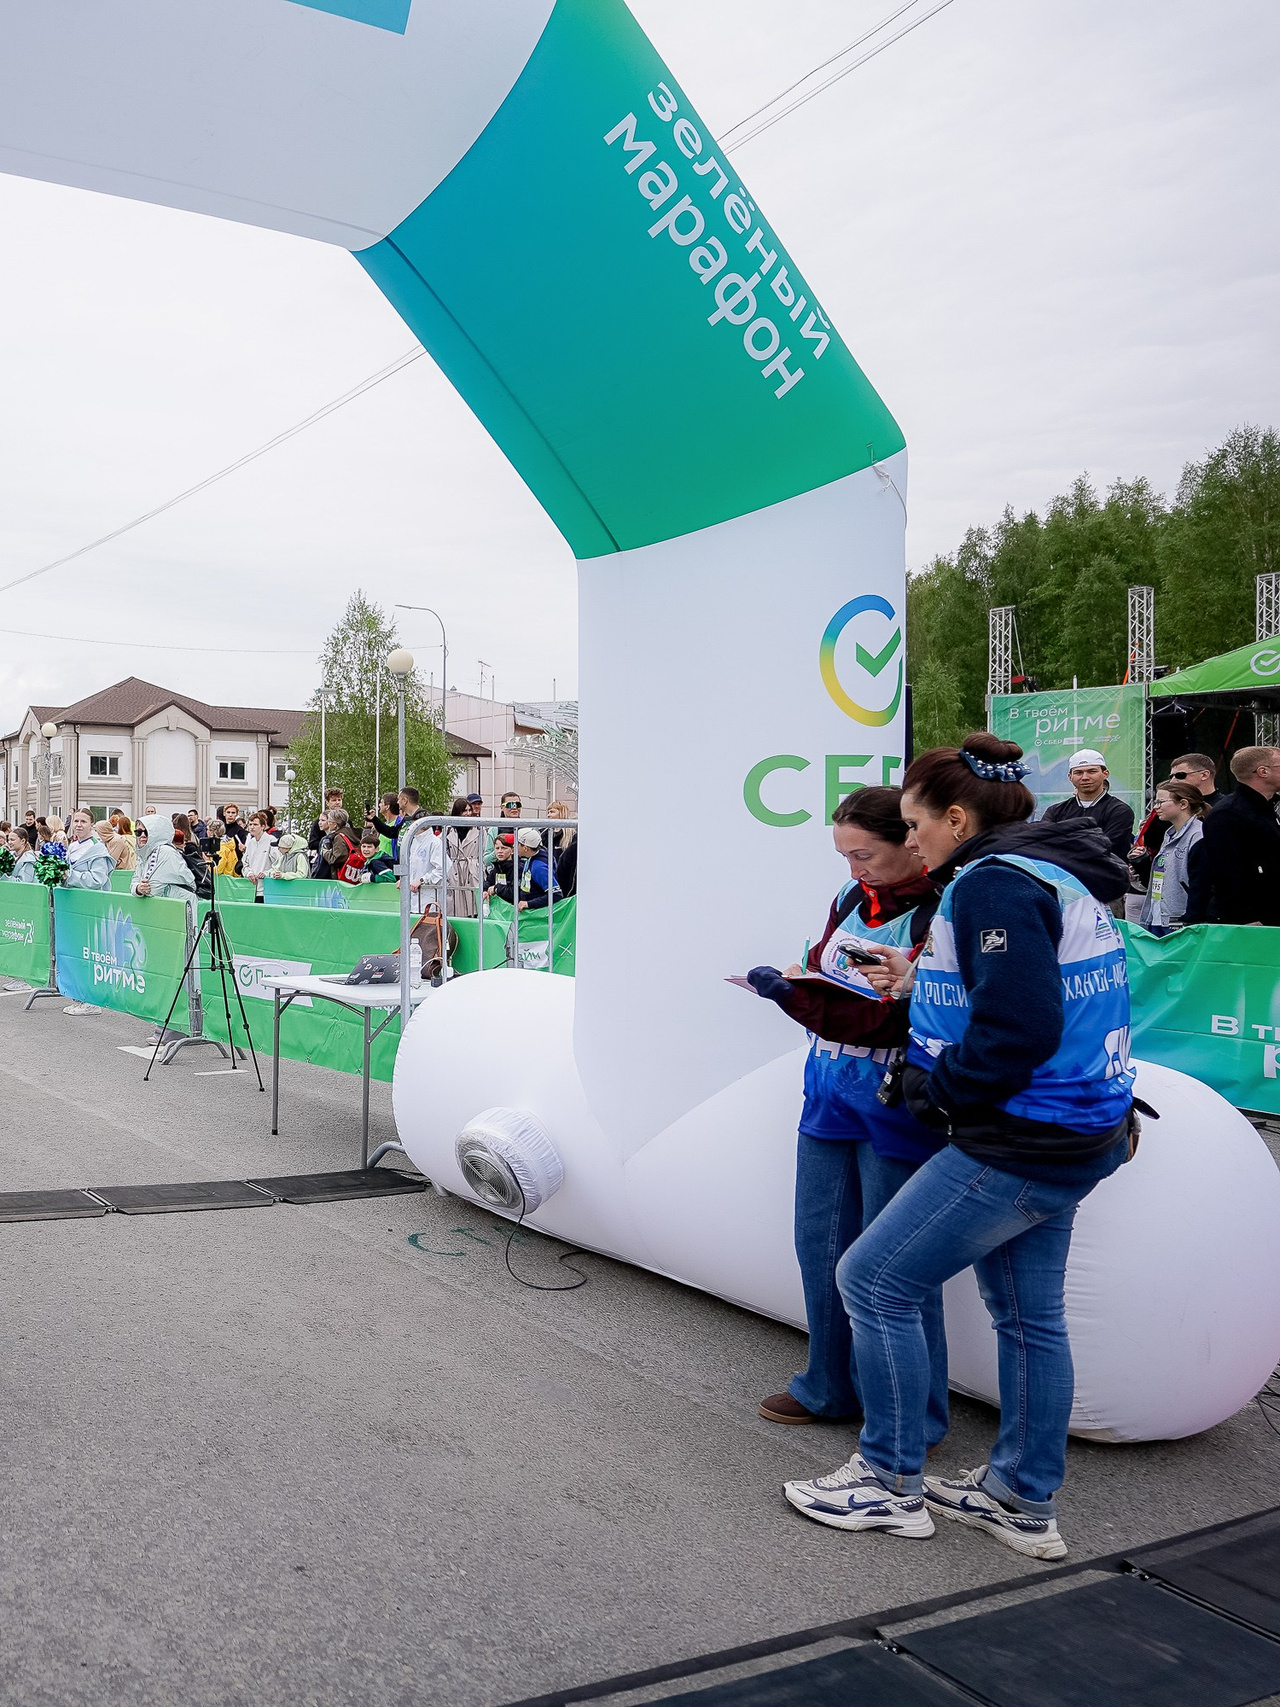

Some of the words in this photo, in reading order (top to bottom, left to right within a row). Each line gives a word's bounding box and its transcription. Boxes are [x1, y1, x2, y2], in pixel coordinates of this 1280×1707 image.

[647, 81, 831, 360] зелёный
[603, 111, 806, 400] марафон
[1009, 707, 1020, 719] В
[1024, 705, 1069, 718] твоём
[1035, 713, 1121, 738] ритме
[83, 946, 90, 959] В
[91, 951, 117, 965] твоём
[94, 963, 146, 993] ритме
[1211, 1014, 1240, 1035] В
